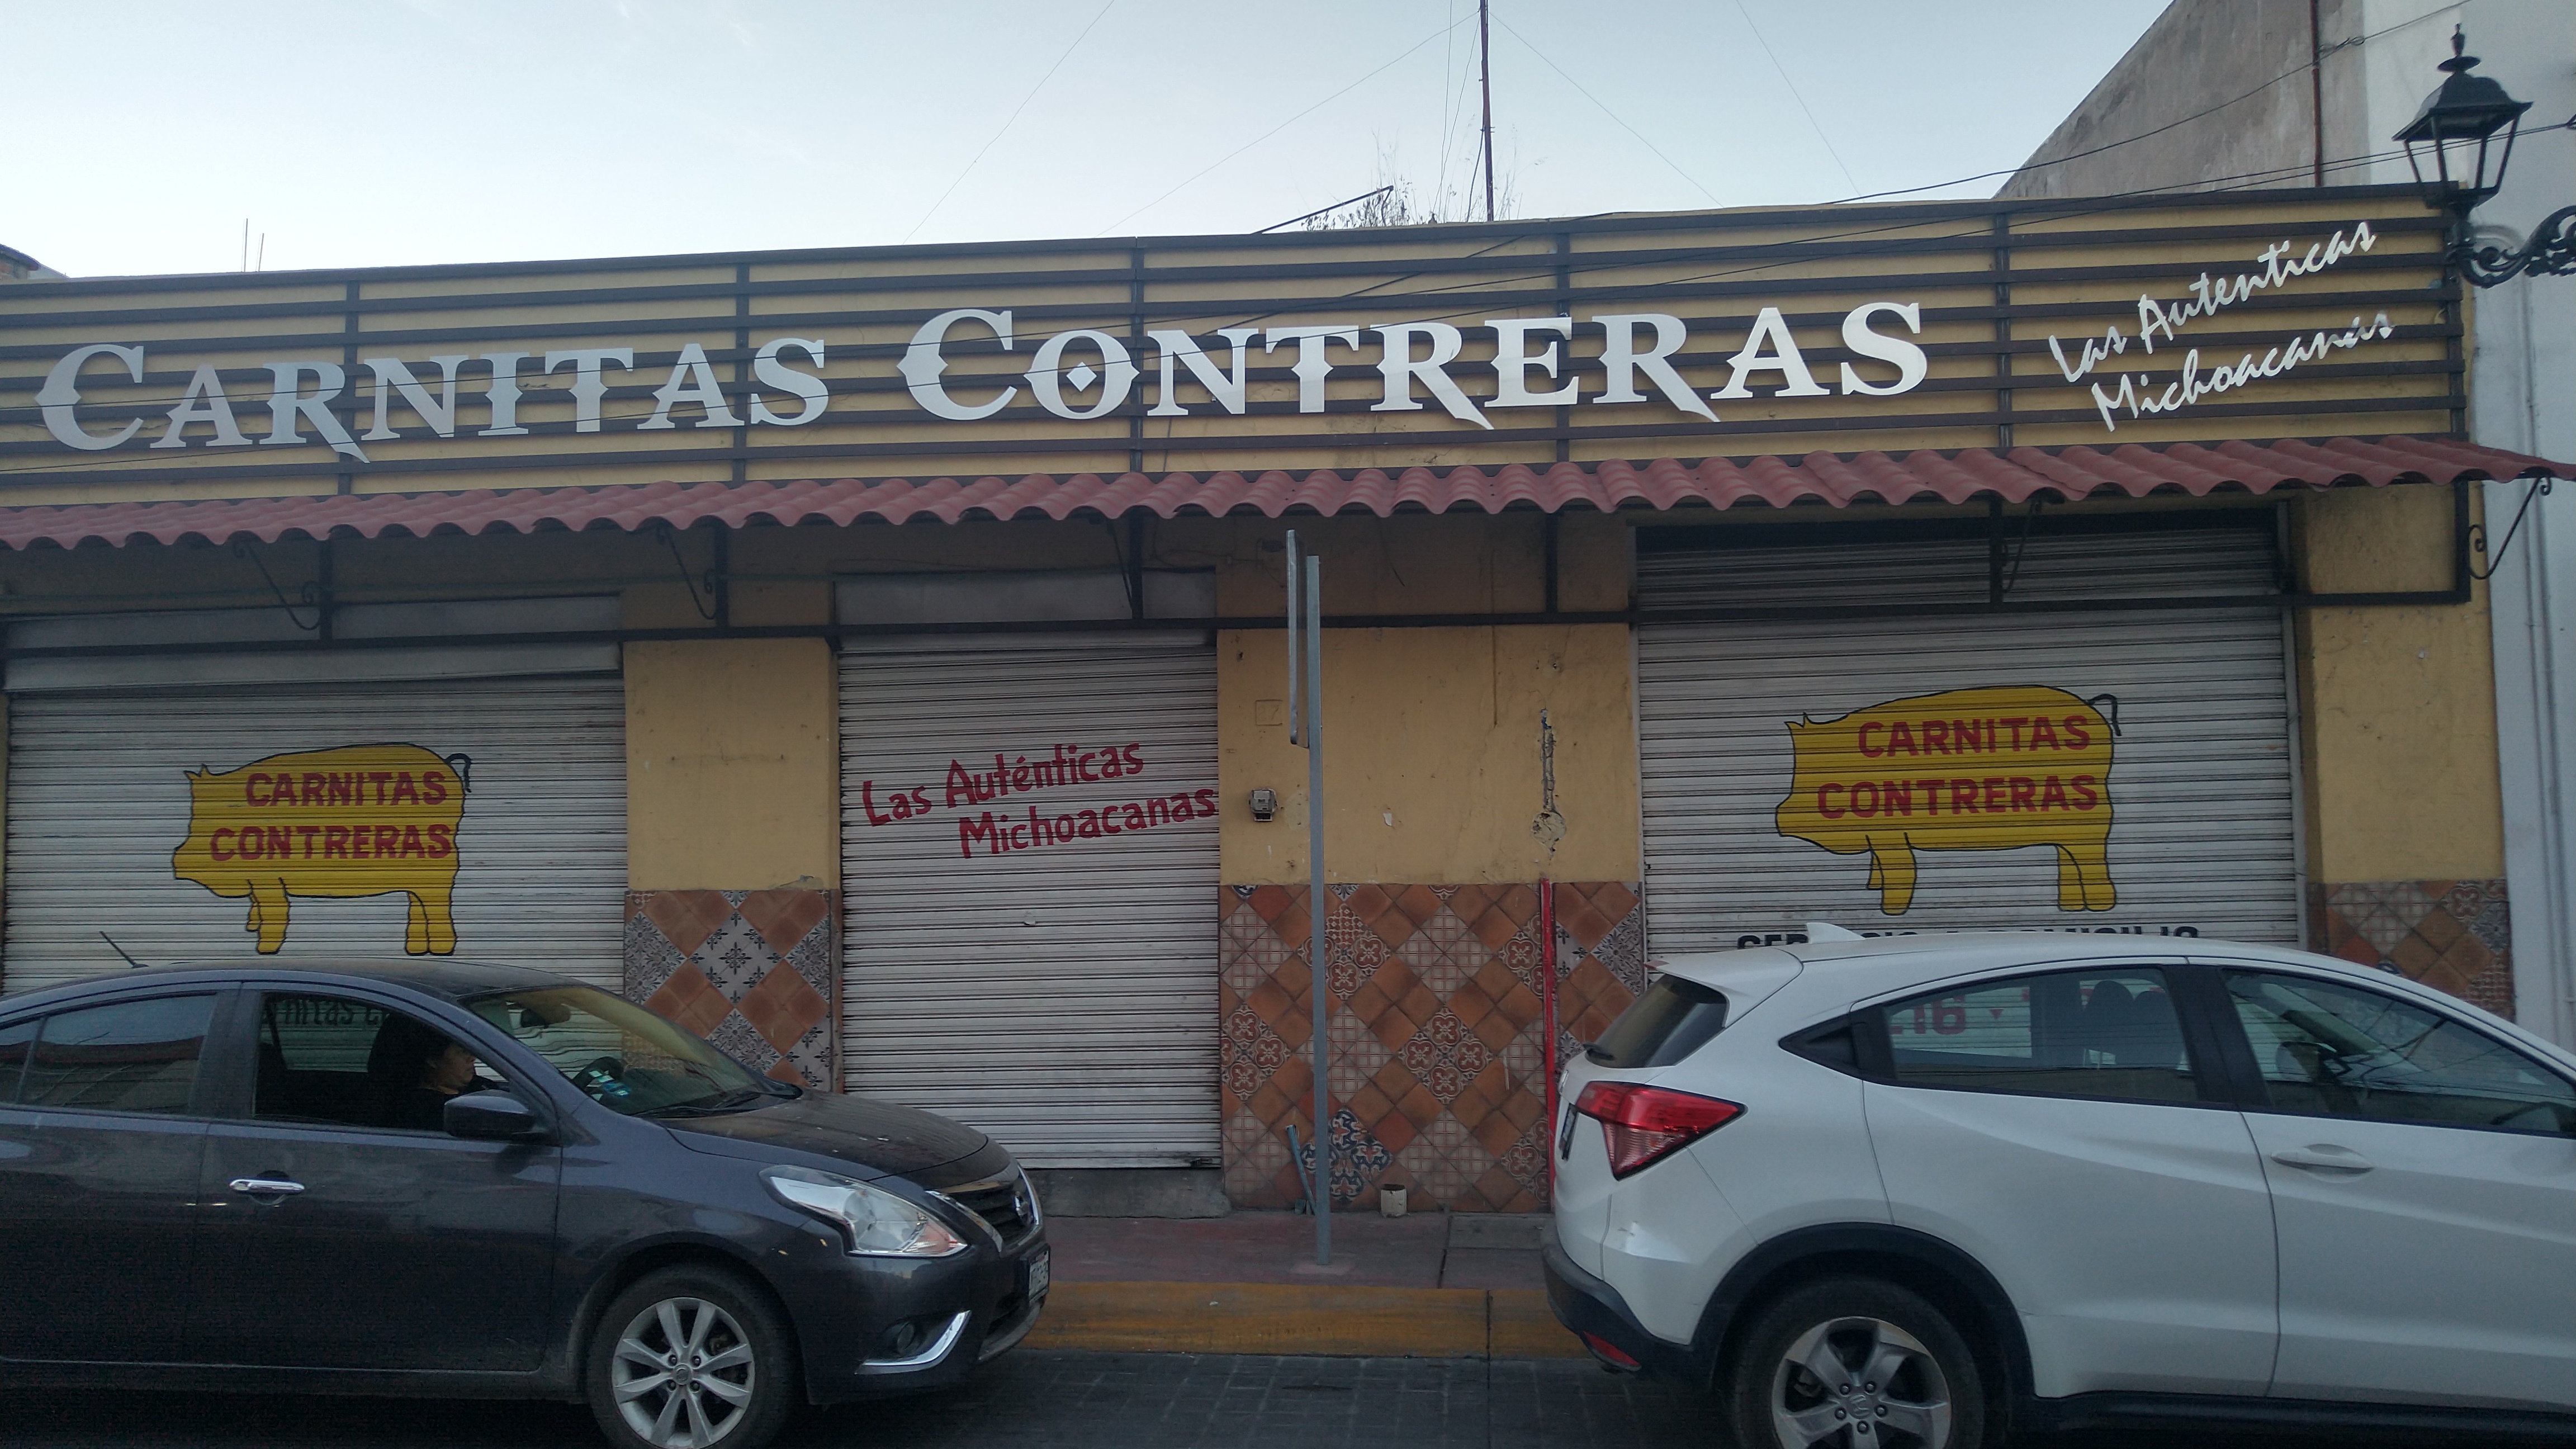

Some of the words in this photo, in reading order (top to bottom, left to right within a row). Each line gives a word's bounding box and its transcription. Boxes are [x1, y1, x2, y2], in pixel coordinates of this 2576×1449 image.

[2049, 326, 2127, 382] Las
[2138, 221, 2378, 354] Autenticas
[34, 337, 830, 463] CARNITAS
[896, 301, 1929, 430] CONTRERAS
[2091, 310, 2395, 432] Michoacanas
[1858, 714, 2091, 758] CARNITAS
[245, 771, 448, 807] CARNITAS
[862, 779, 932, 827] Las
[945, 742, 1144, 809] Auténticas
[1817, 774, 2099, 820] CONTRERAS
[209, 823, 453, 861] CONTRERAS
[958, 788, 1218, 859] Michoacanas
